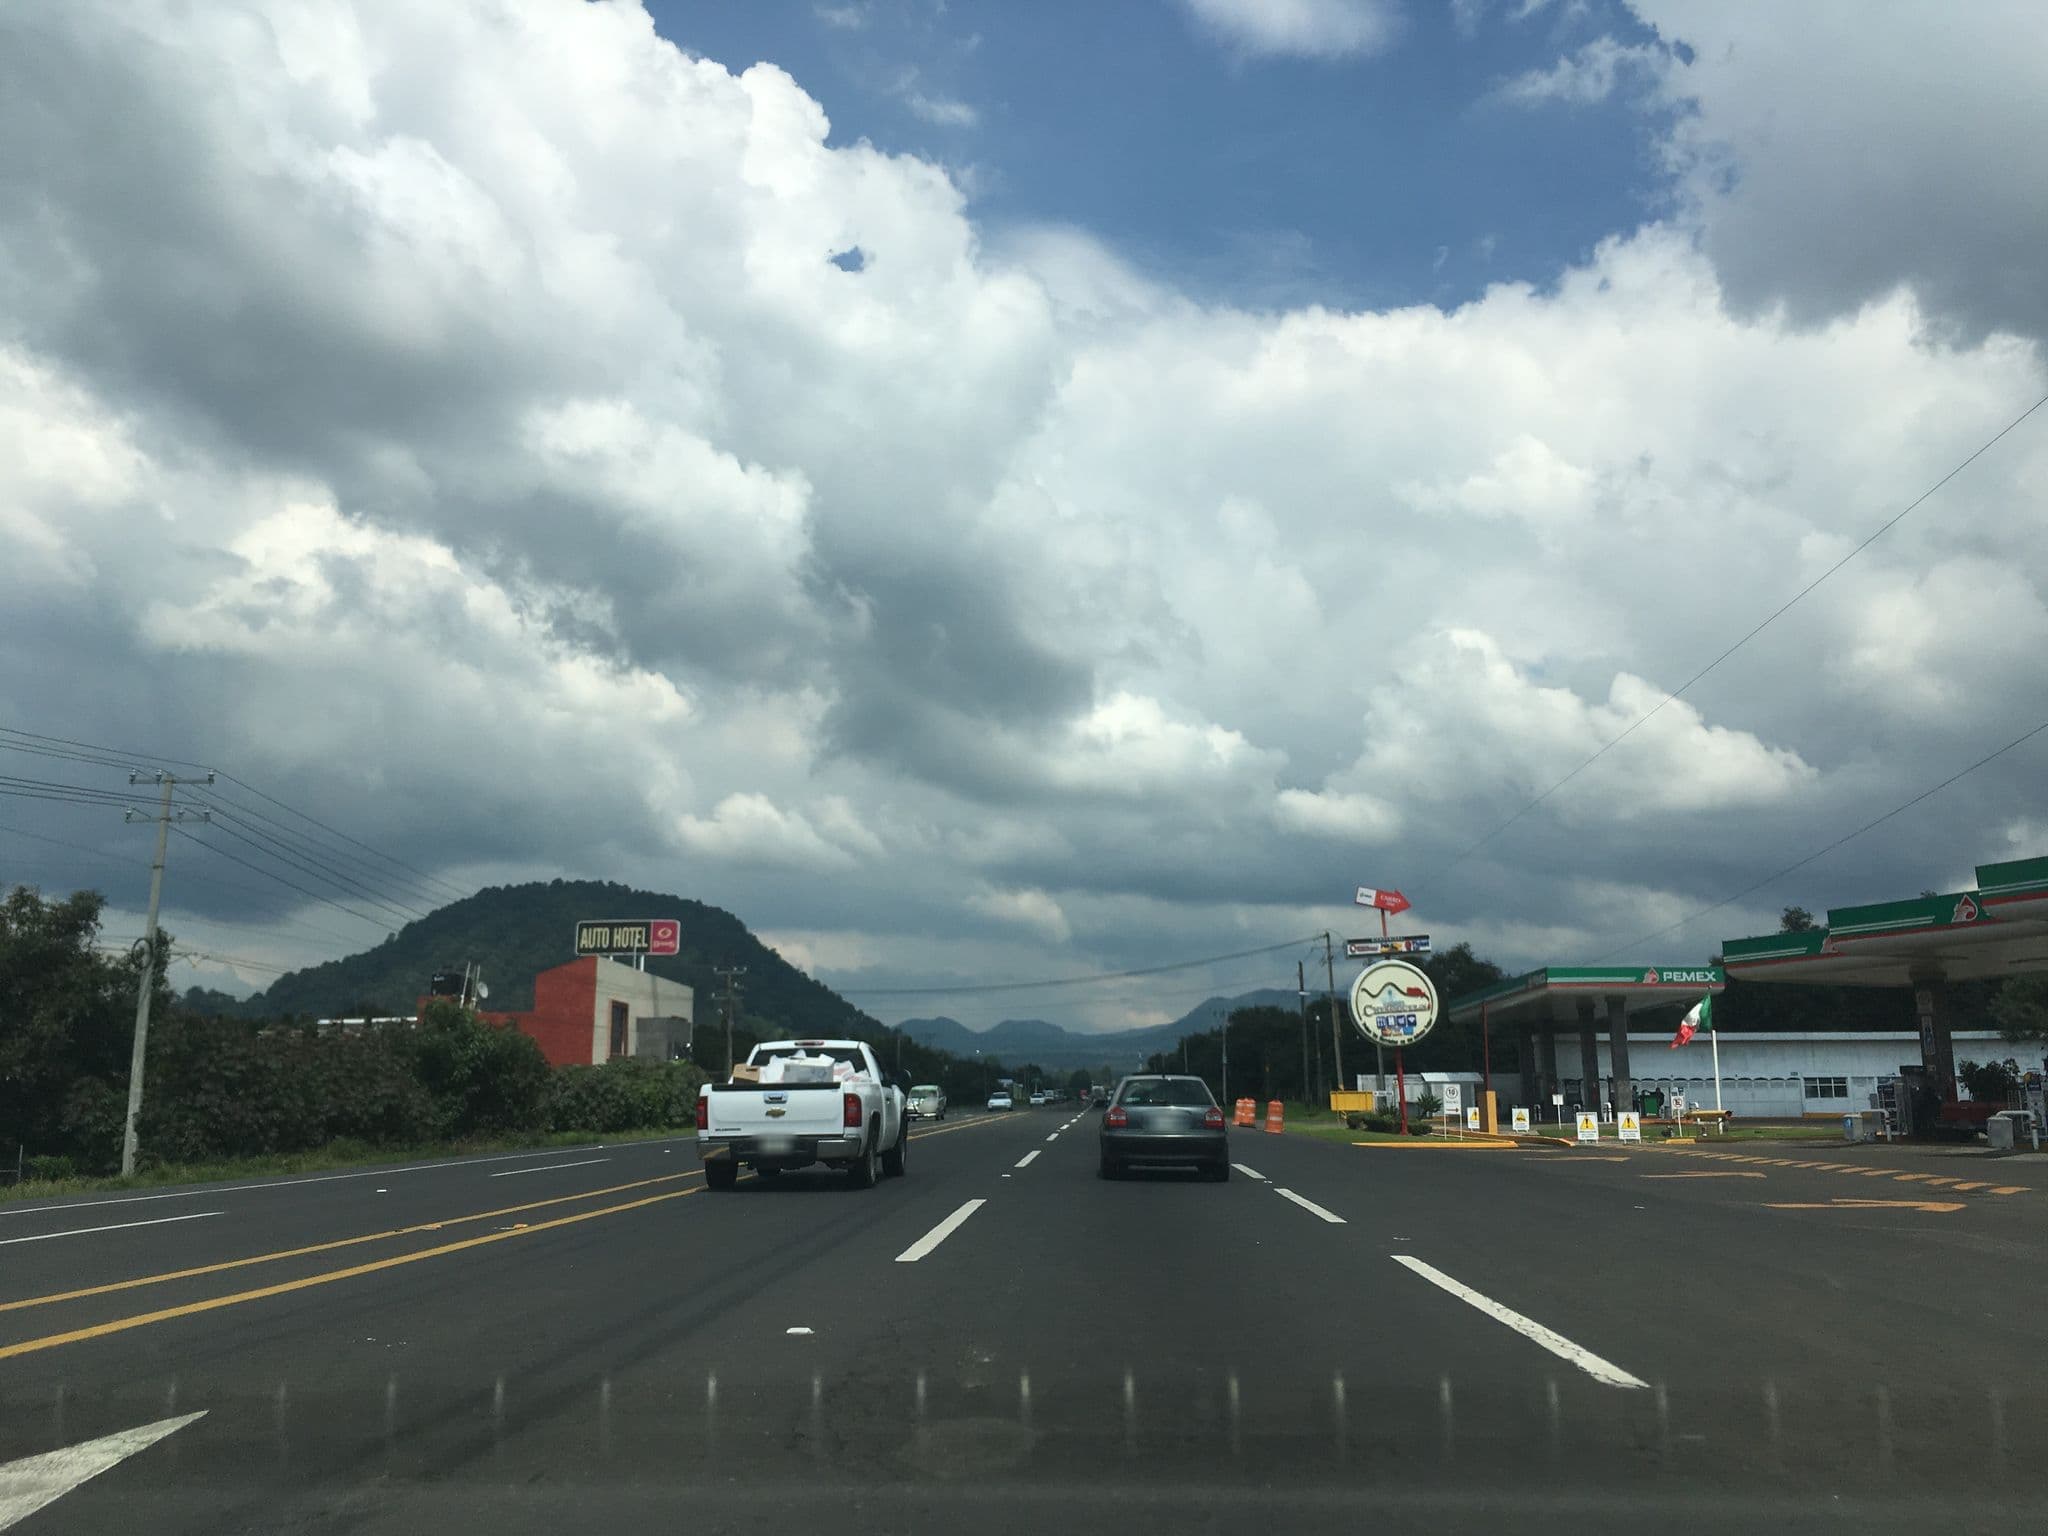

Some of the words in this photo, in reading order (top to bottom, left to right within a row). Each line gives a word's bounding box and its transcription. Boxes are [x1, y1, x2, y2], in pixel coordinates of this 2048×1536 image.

[579, 927, 609, 948] AUTO
[613, 927, 648, 948] HOTEL
[1663, 971, 1716, 982] PEMEX
